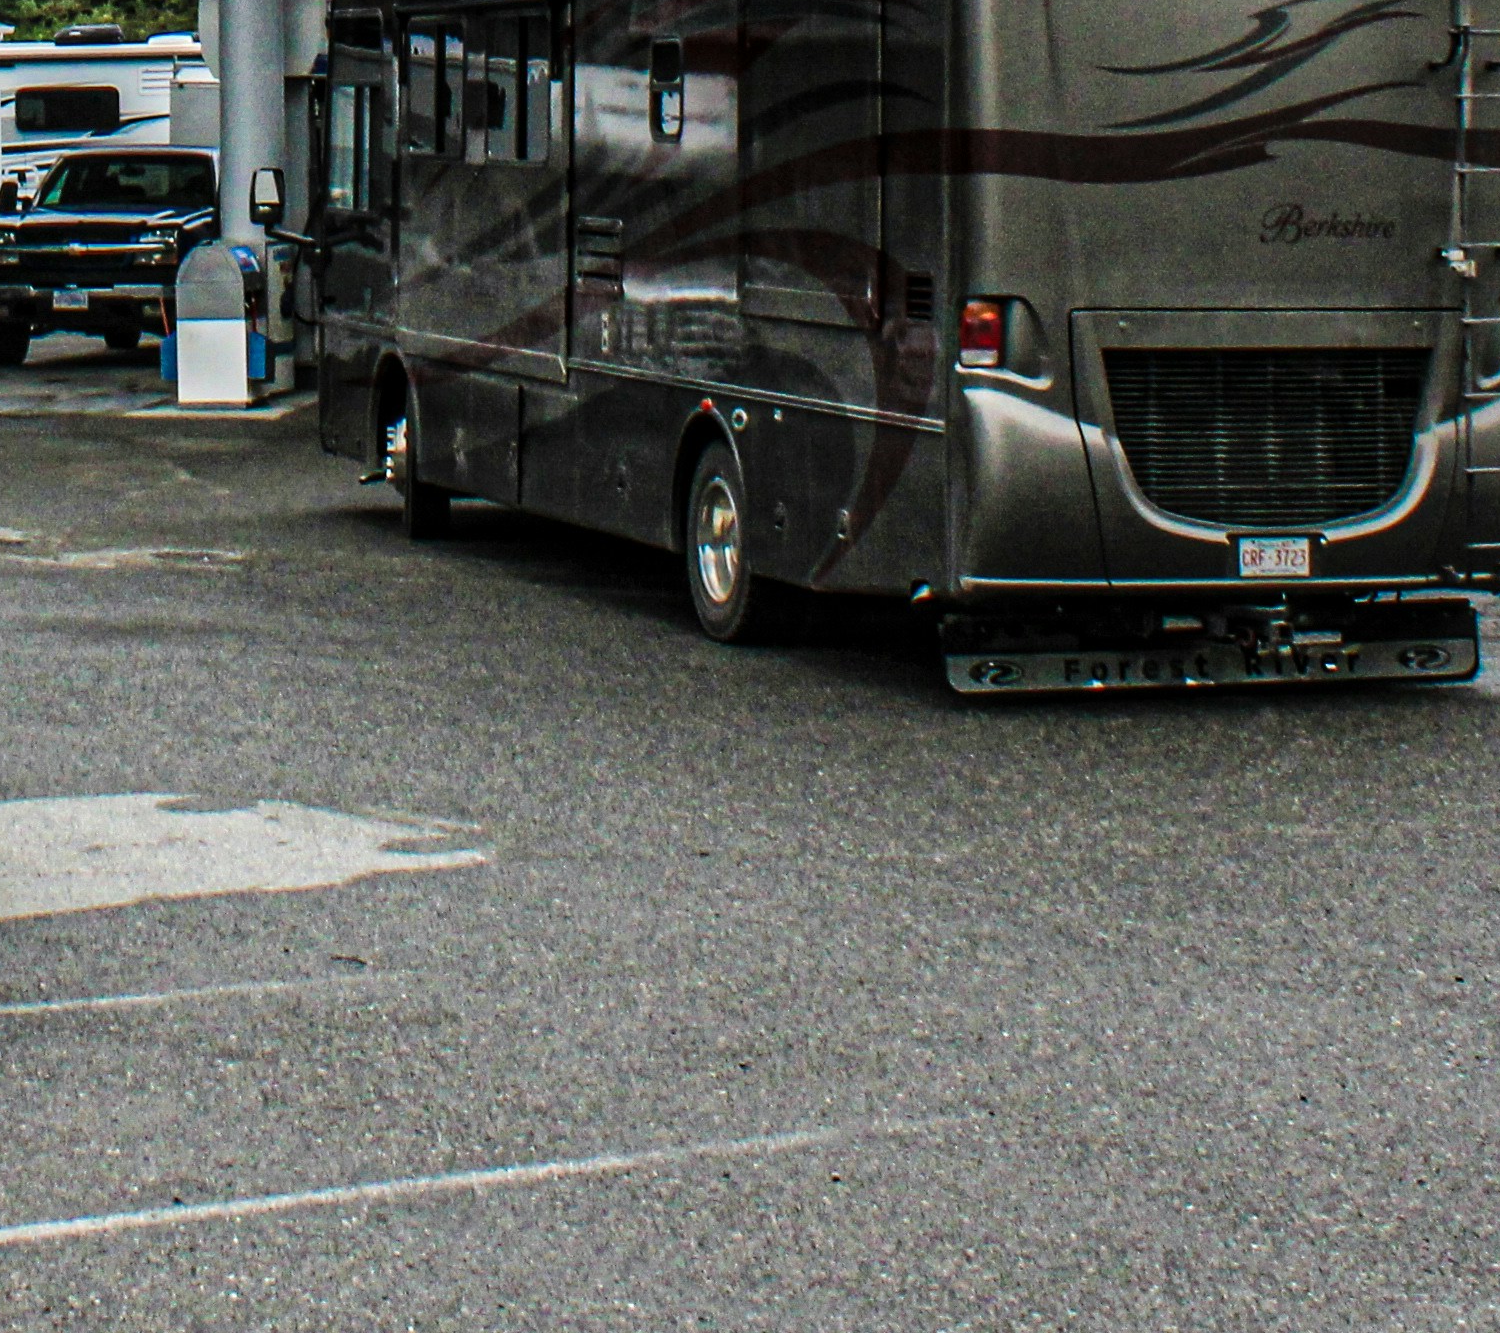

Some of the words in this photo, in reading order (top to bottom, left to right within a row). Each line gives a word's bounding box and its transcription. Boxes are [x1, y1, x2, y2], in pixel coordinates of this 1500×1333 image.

[1259, 203, 1396, 244] Berkshire
[1064, 654, 1208, 681] Forest
[1243, 644, 1362, 675] River
